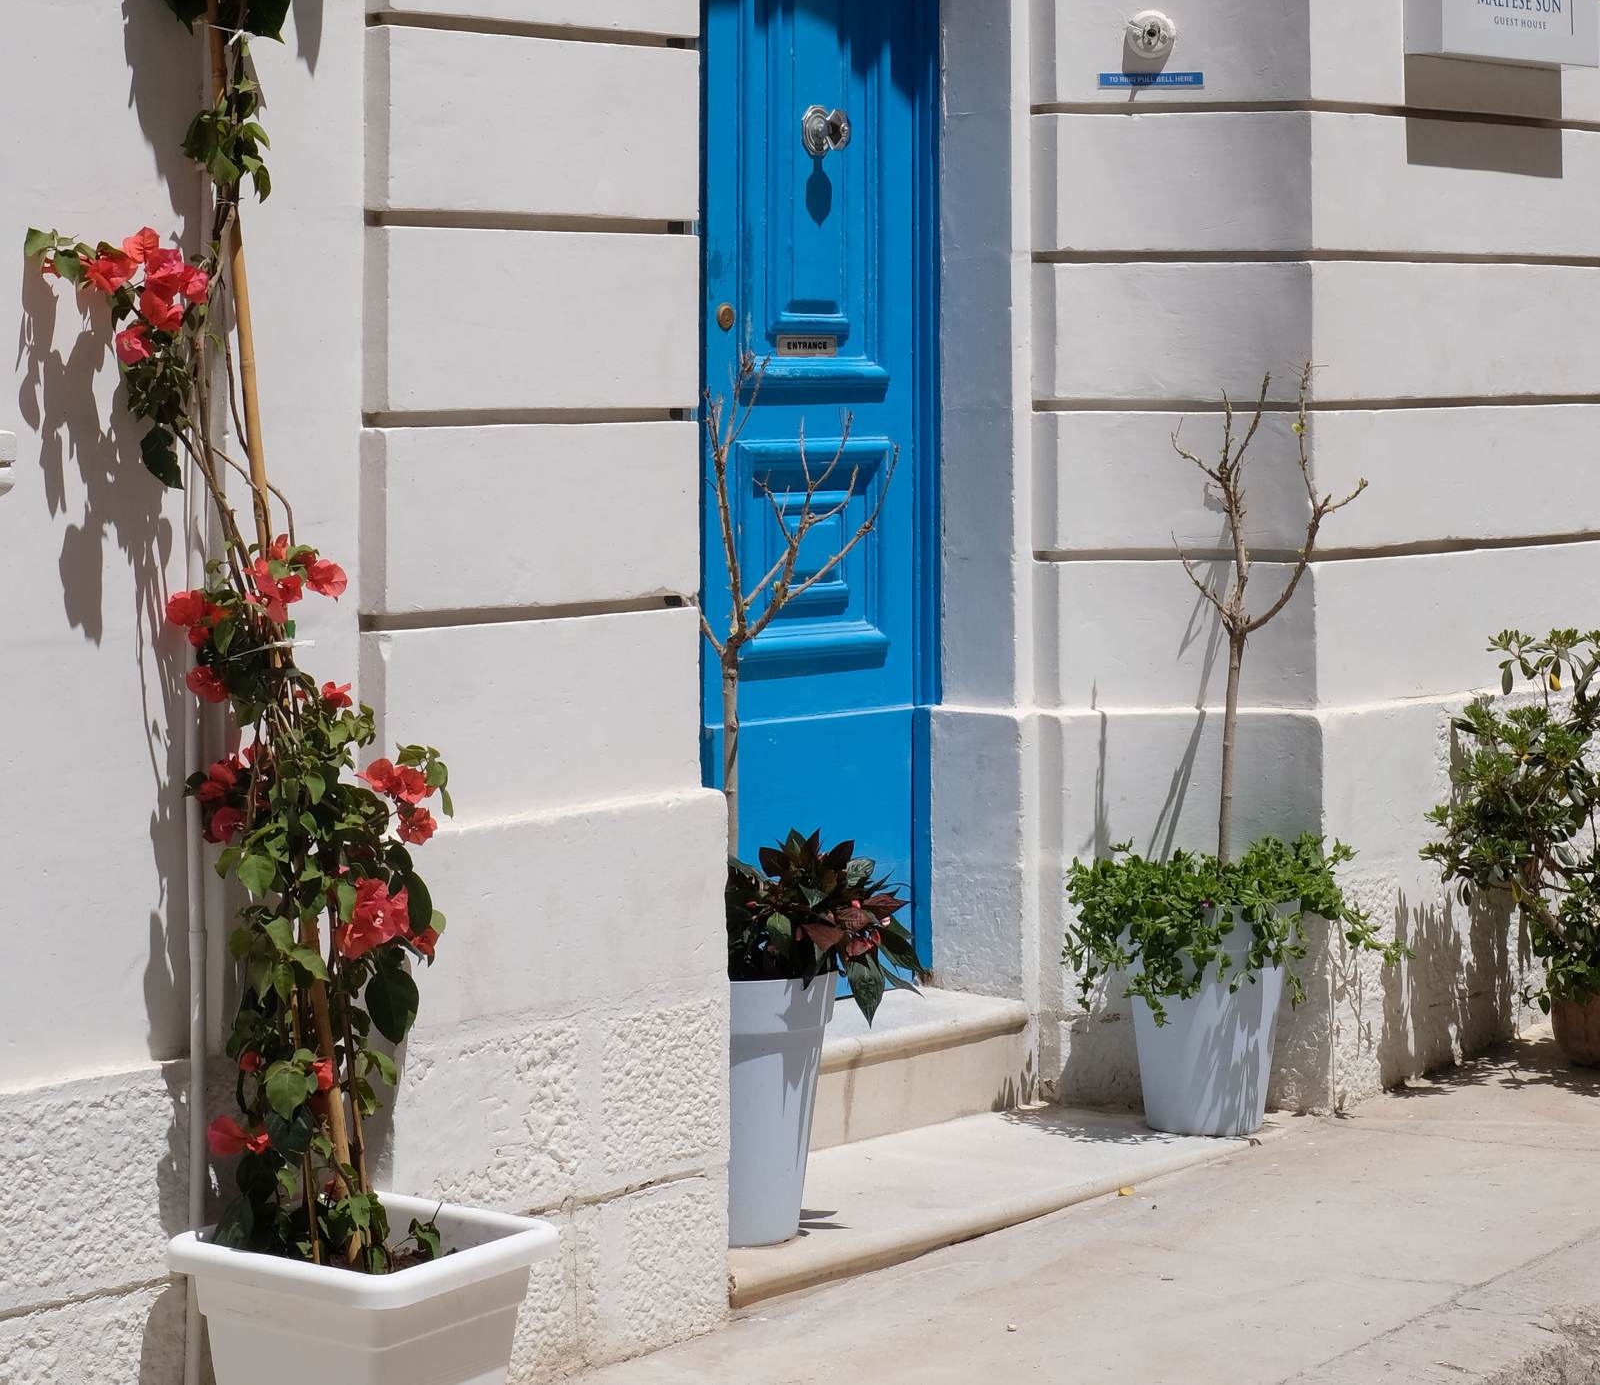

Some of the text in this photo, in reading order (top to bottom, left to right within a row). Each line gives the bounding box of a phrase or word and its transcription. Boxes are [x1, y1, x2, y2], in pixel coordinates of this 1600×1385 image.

[1493, 16, 1547, 30] GUEST HOUSE
[787, 341, 828, 350] ENTRANCE
